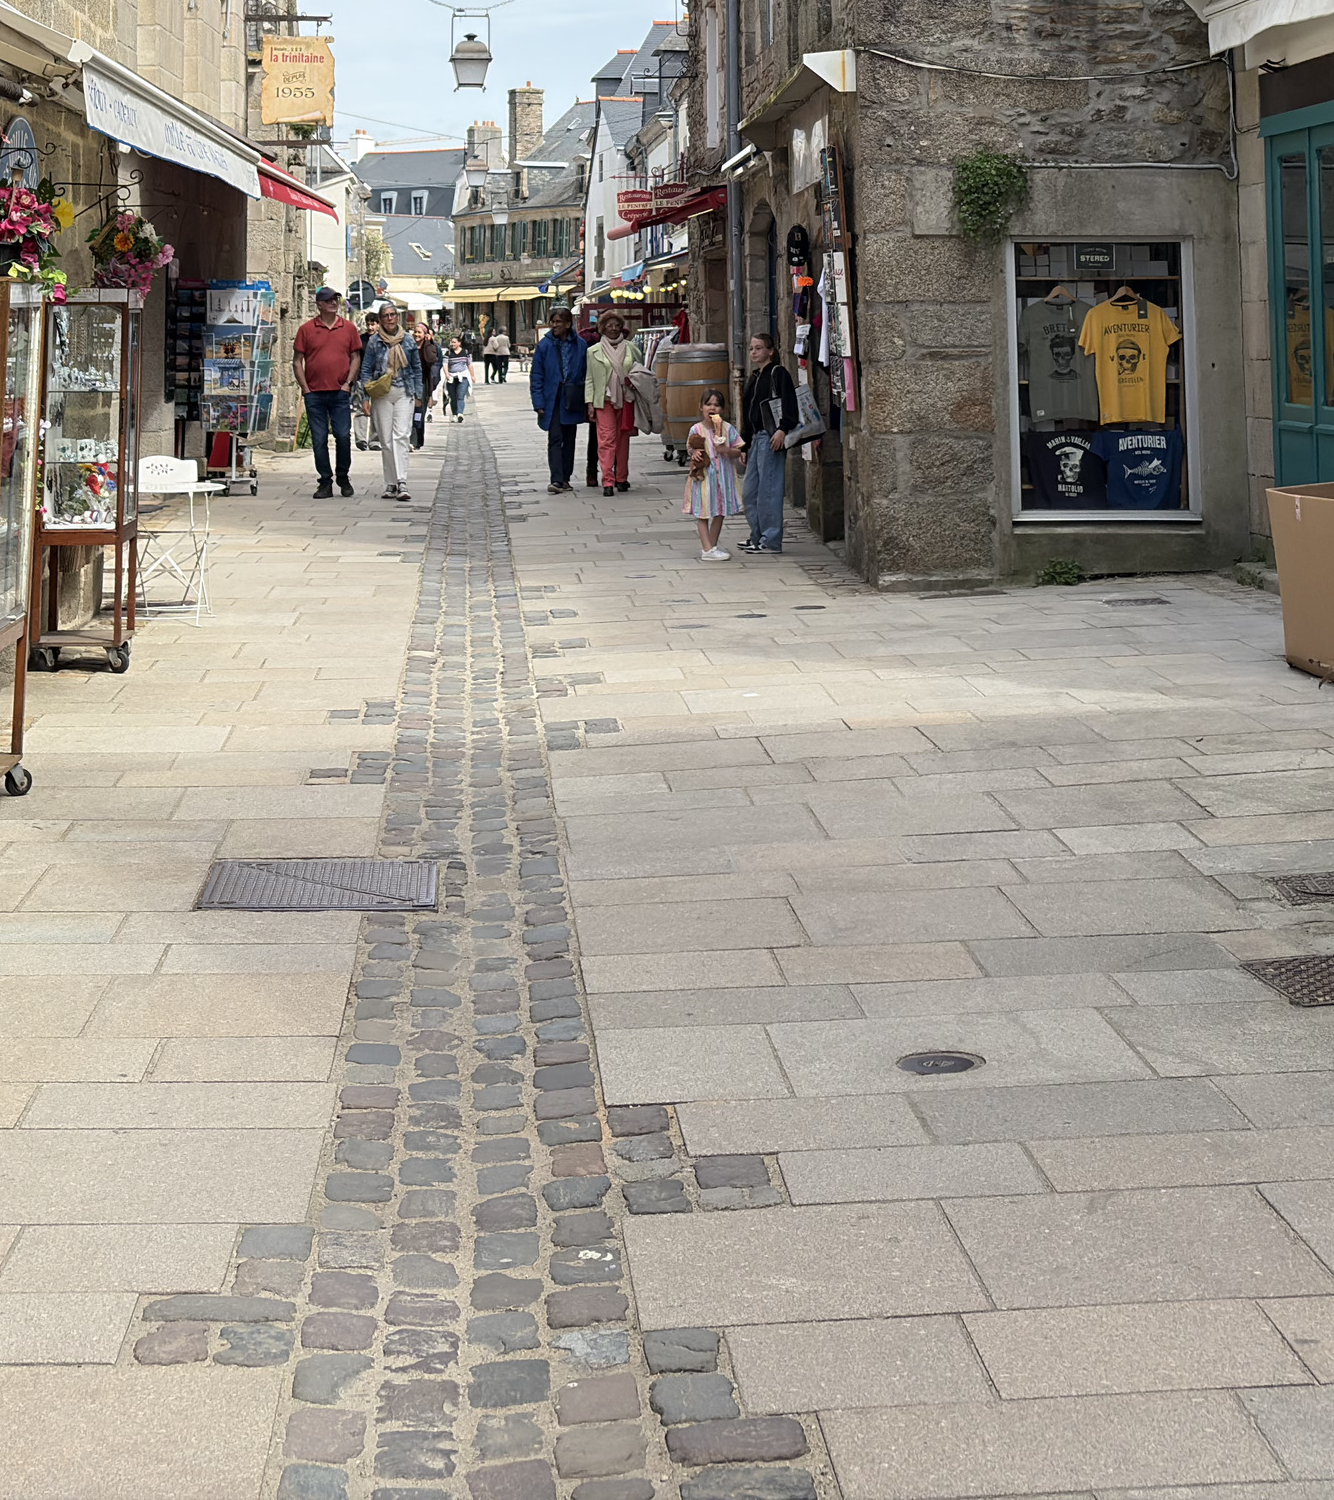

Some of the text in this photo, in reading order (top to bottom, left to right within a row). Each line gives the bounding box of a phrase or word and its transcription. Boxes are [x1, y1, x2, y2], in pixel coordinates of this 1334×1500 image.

[270, 46, 325, 64] la trinitaine
[275, 87, 315, 99] 1955
[1104, 323, 1150, 336] AVENTURIER
[1118, 435, 1167, 451] AVENTURIER
